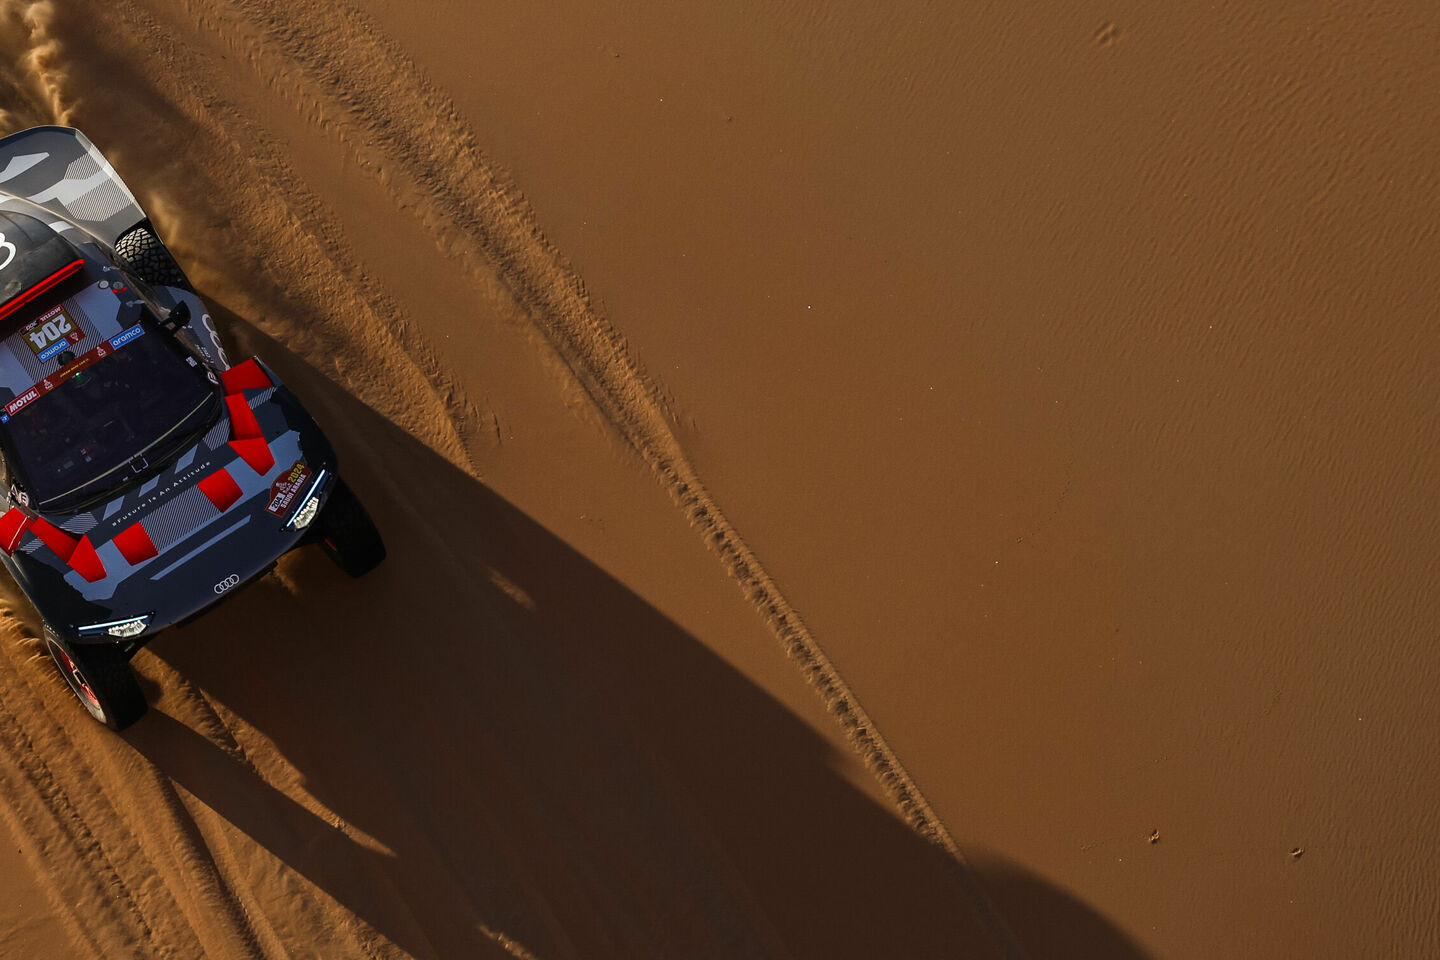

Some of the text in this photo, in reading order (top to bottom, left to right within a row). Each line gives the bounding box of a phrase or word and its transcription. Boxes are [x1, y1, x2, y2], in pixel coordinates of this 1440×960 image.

[40, 306, 61, 322] MOTUL
[29, 314, 72, 349] 204
[112, 327, 141, 346] aramco
[40, 341, 67, 360] aramco
[9, 390, 37, 413] MOTUL
[160, 487, 170, 496] An
[173, 461, 210, 487] Attitude
[288, 463, 305, 483] 2024
[280, 474, 307, 509] SAUDI ARABIA
[271, 497, 283, 509] 204
